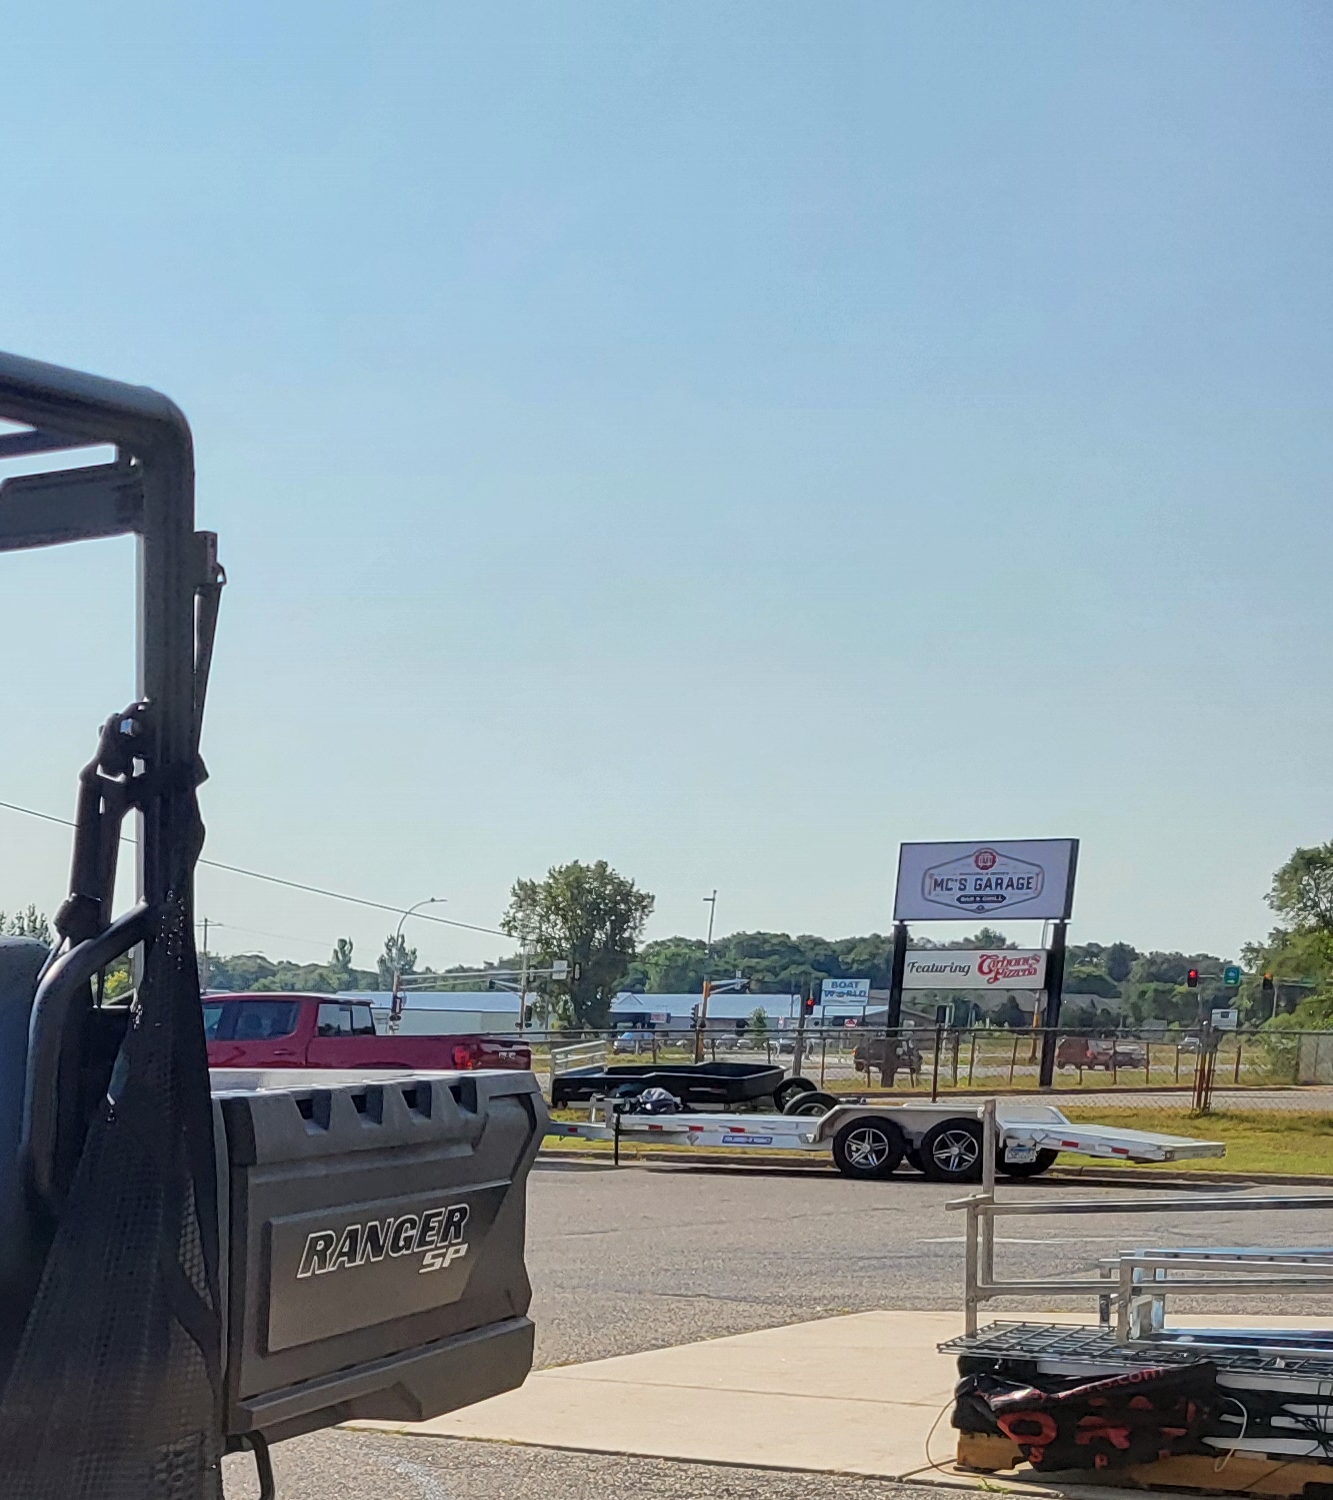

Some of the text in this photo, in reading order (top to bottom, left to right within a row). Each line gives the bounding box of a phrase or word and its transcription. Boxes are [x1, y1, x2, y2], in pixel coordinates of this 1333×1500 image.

[974, 876, 1034, 891] GARAGE
[907, 961, 971, 977] Featuring
[830, 980, 859, 989] BOAT
[296, 1202, 470, 1279] RANGER
[418, 1242, 469, 1274] SP
